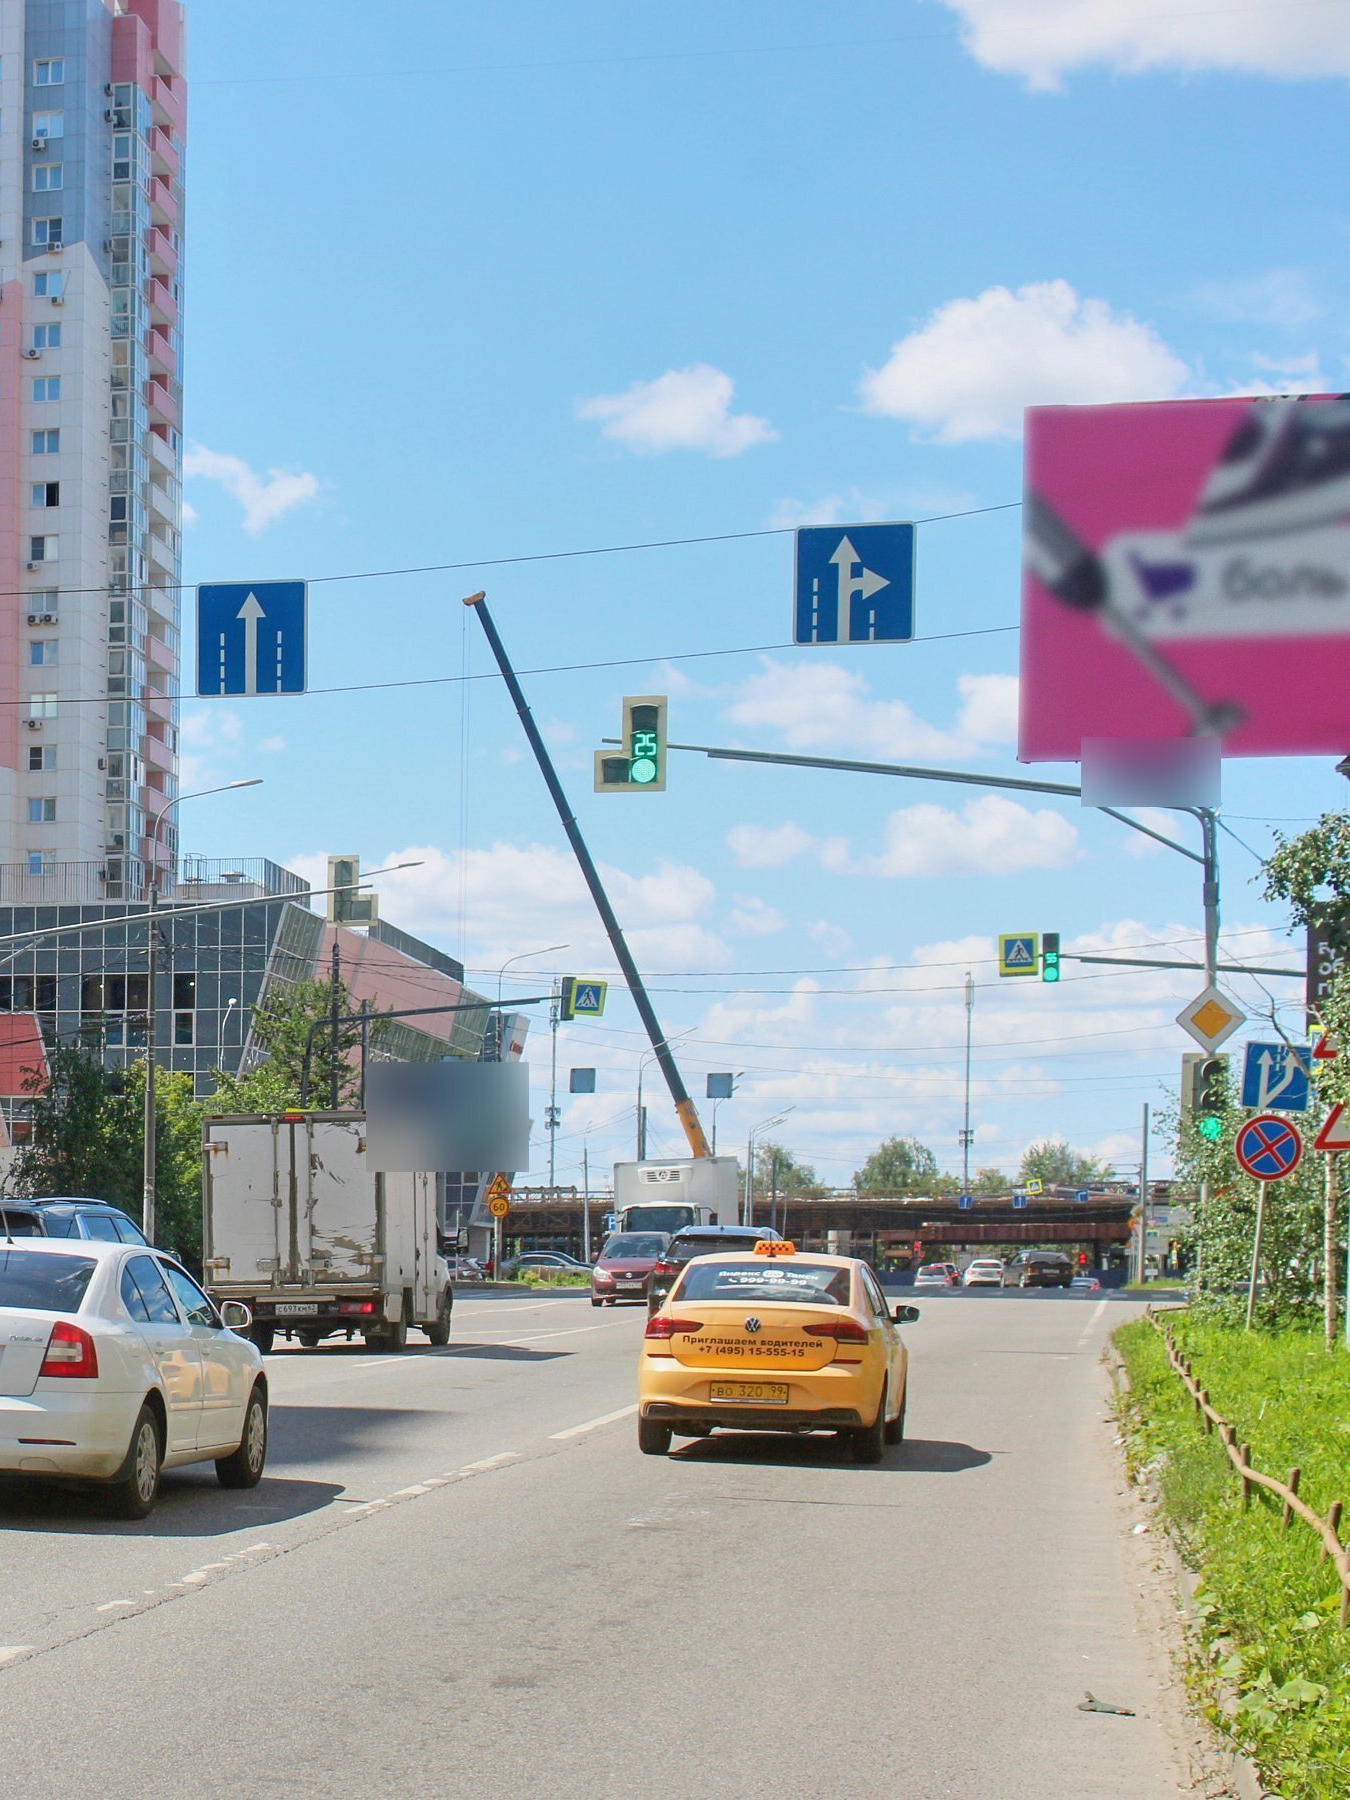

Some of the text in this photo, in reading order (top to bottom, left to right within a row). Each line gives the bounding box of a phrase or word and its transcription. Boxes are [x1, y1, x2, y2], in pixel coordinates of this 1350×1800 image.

[635, 733, 657, 755] 25
[493, 1203, 505, 1211] 60
[683, 1335, 822, 1348] Приглашаем водителей
[699, 1345, 804, 1357] +7 (495) 15-555-15
